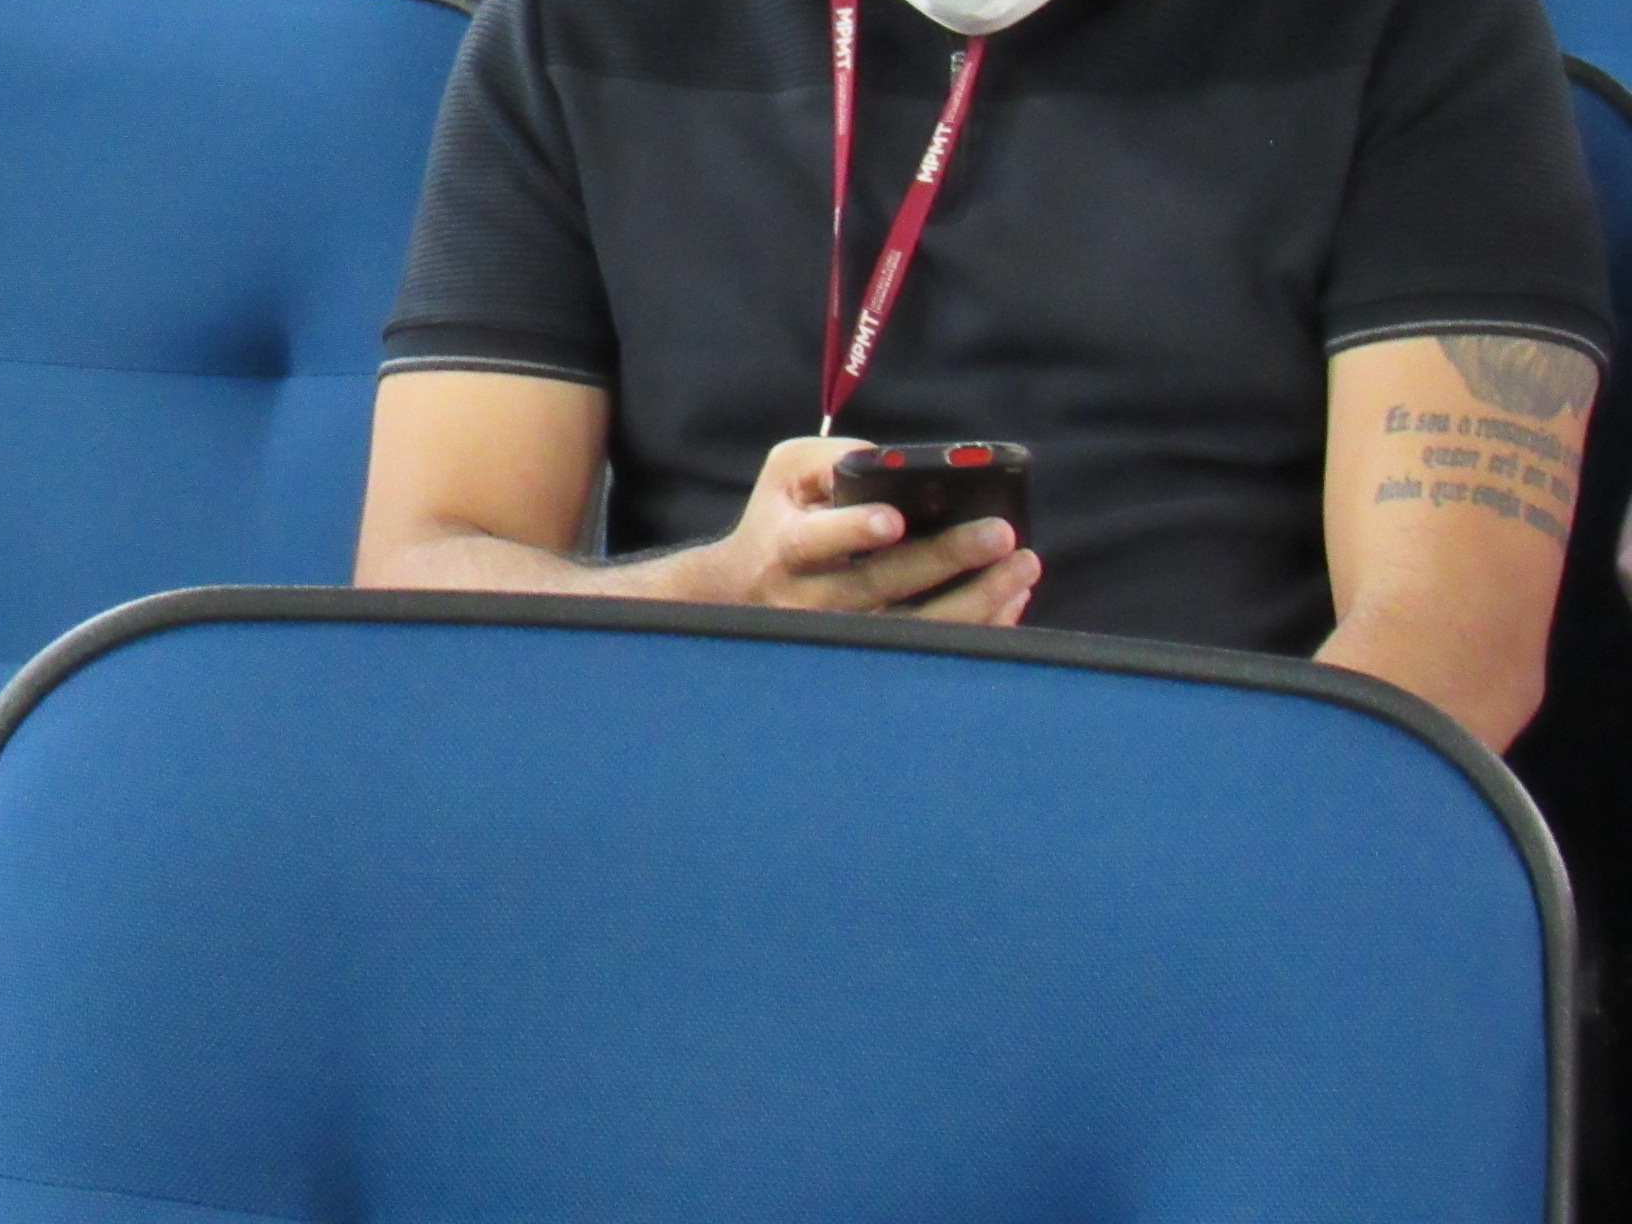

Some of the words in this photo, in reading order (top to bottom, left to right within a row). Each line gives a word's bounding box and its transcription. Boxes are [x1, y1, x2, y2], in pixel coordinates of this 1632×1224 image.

[835, 8, 855, 70] MPMT
[915, 121, 954, 184] MPMT
[845, 308, 881, 376] MPMT
